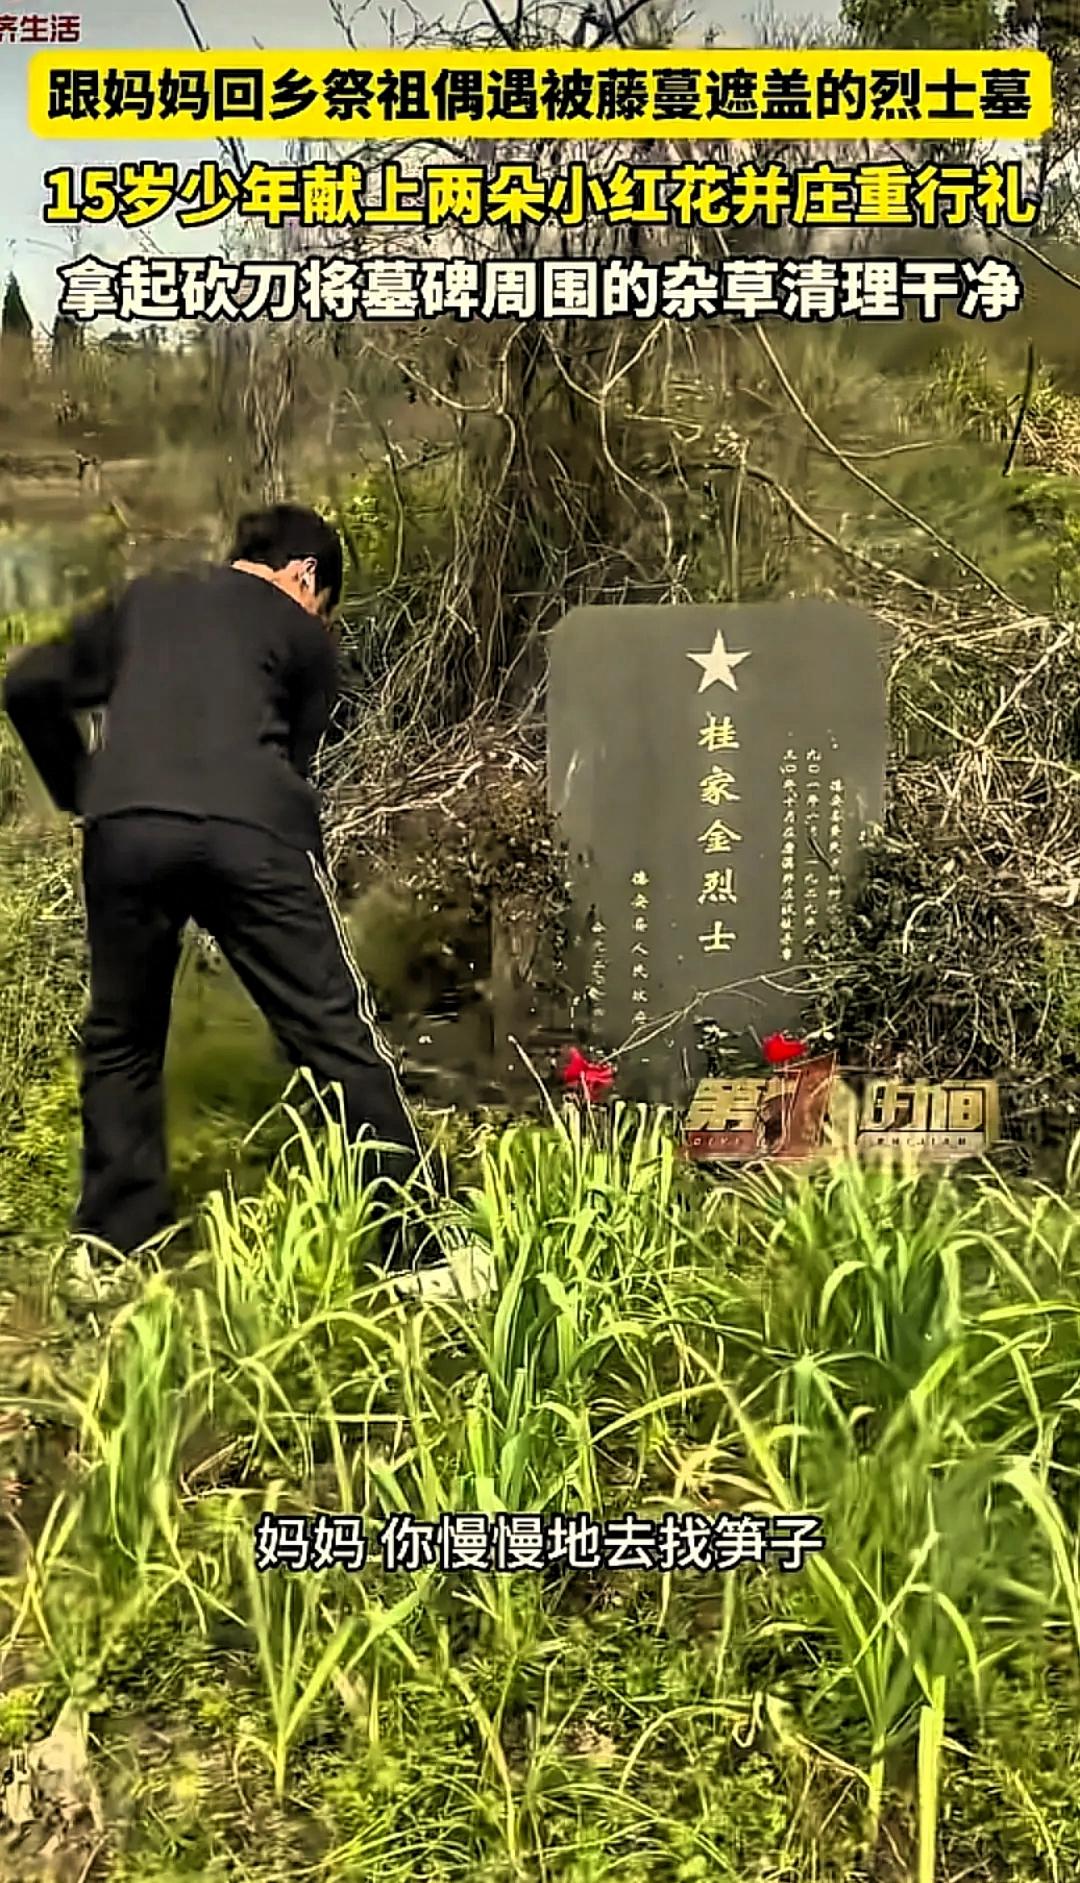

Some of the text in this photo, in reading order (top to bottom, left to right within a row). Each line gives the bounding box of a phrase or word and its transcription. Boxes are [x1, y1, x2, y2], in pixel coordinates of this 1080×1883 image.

[697, 714, 742, 952] 桂家金烈士
